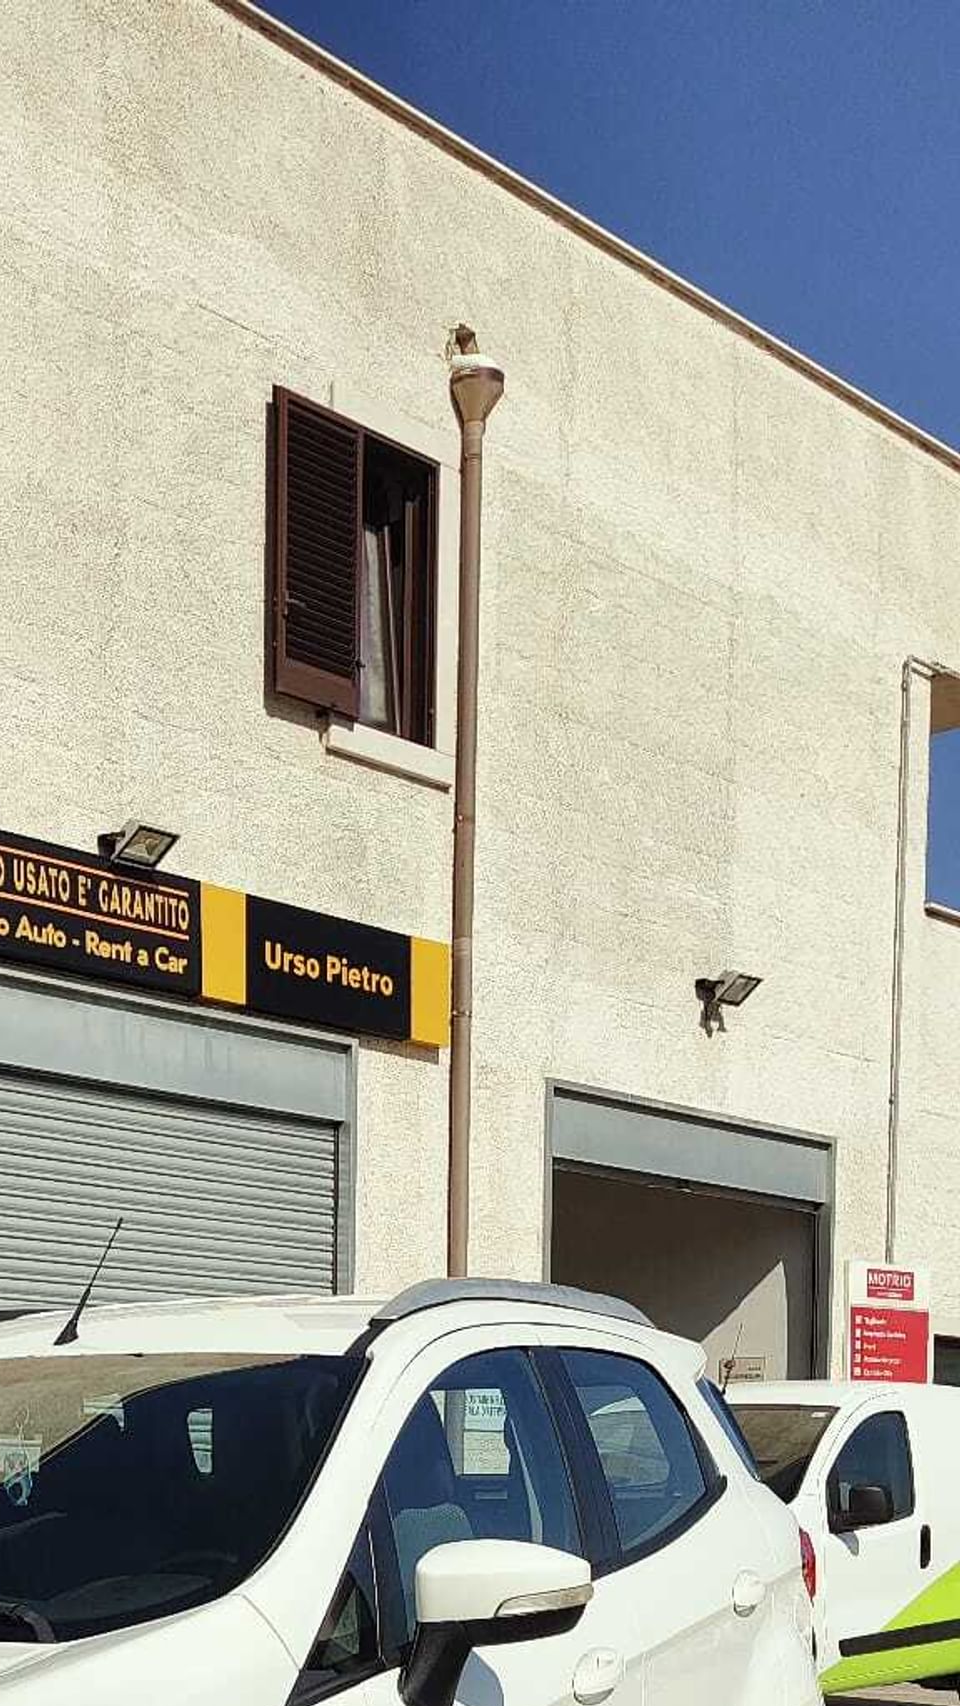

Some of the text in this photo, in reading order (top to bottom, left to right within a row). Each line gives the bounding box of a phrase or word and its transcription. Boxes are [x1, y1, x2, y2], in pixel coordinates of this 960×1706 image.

[13, 858, 71, 902] USATO
[98, 883, 189, 931] GARANTITO
[15, 914, 67, 948] Auto
[85, 931, 132, 963] Rent
[137, 949, 149, 968] a
[154, 946, 188, 975] Car
[264, 940, 393, 996] Urso Pietro
